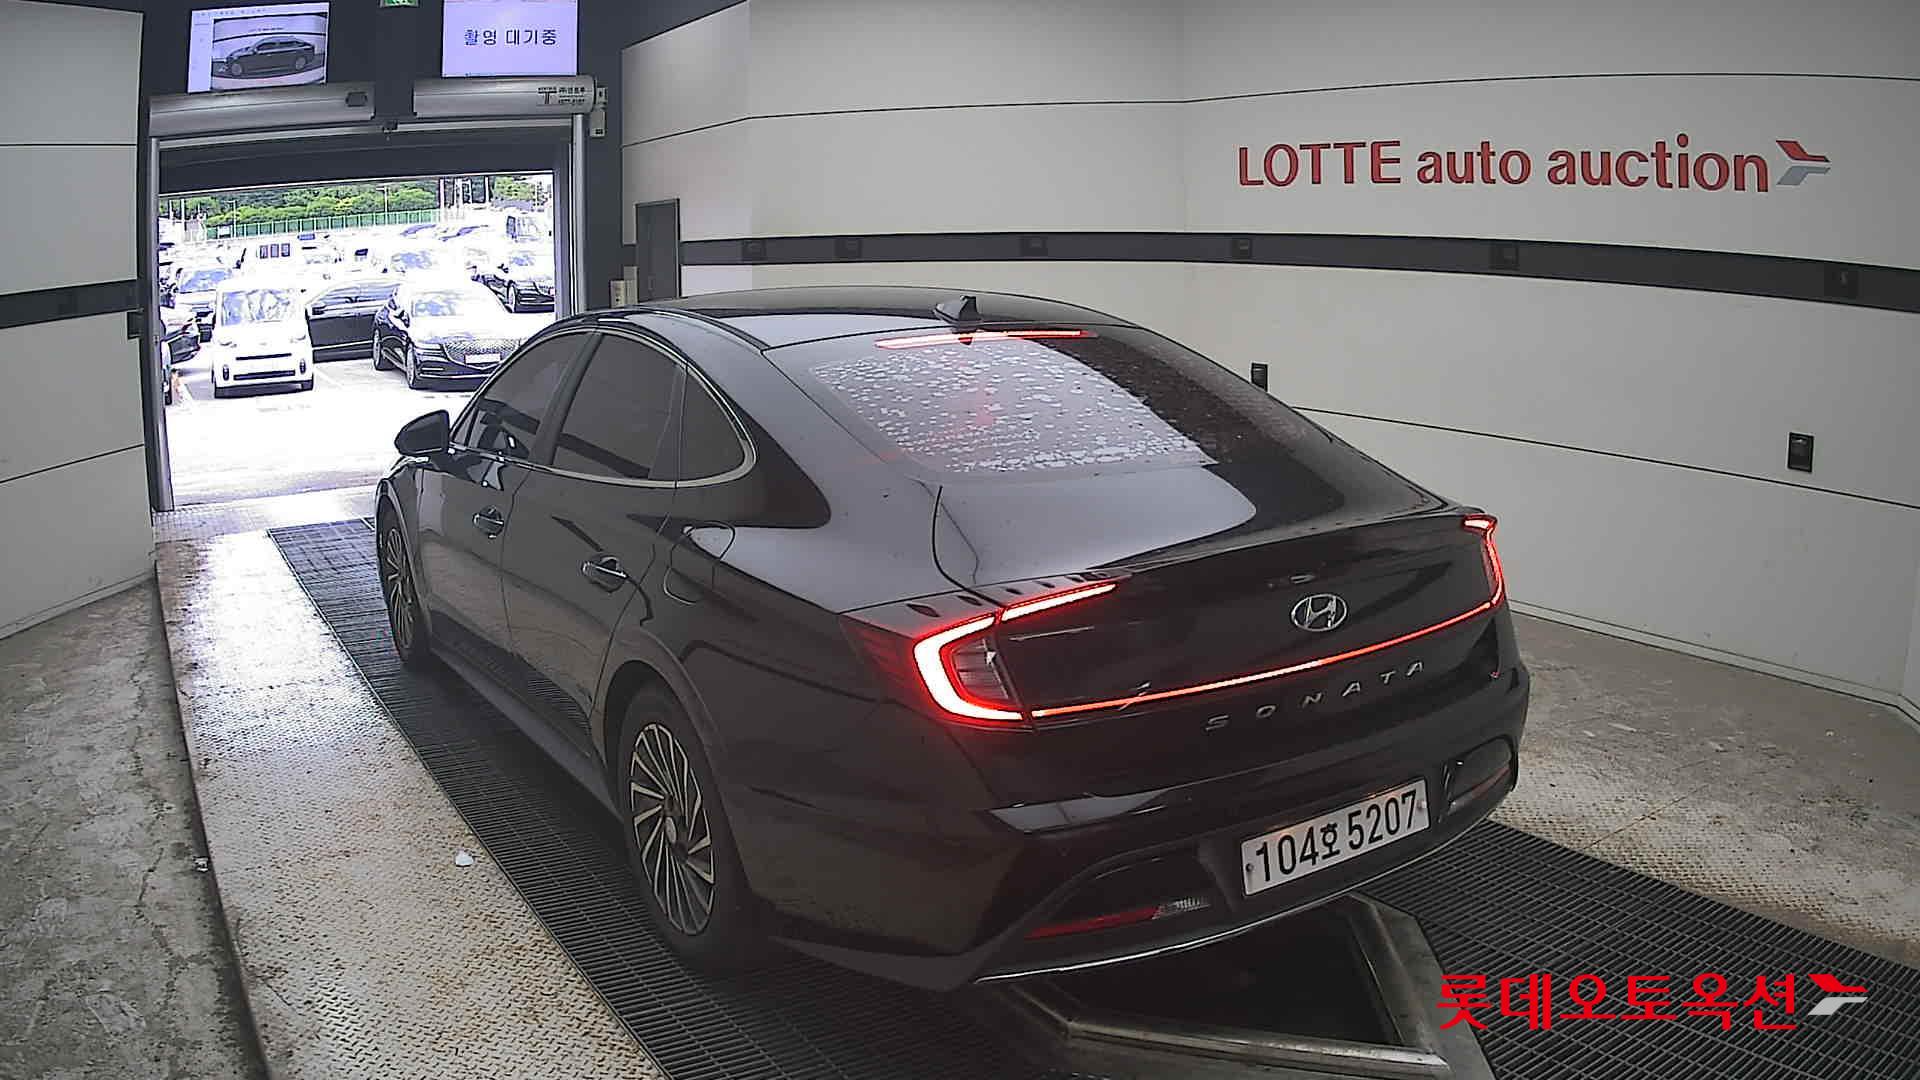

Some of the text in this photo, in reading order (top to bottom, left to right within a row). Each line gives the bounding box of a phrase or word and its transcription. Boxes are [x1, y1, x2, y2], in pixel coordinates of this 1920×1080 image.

[464, 29, 557, 46] 촬영 대기중
[1239, 133, 1769, 193] LOTTE auto auction
[1205, 660, 1425, 731] SONATA
[1256, 789, 1417, 882] 104호 5207
